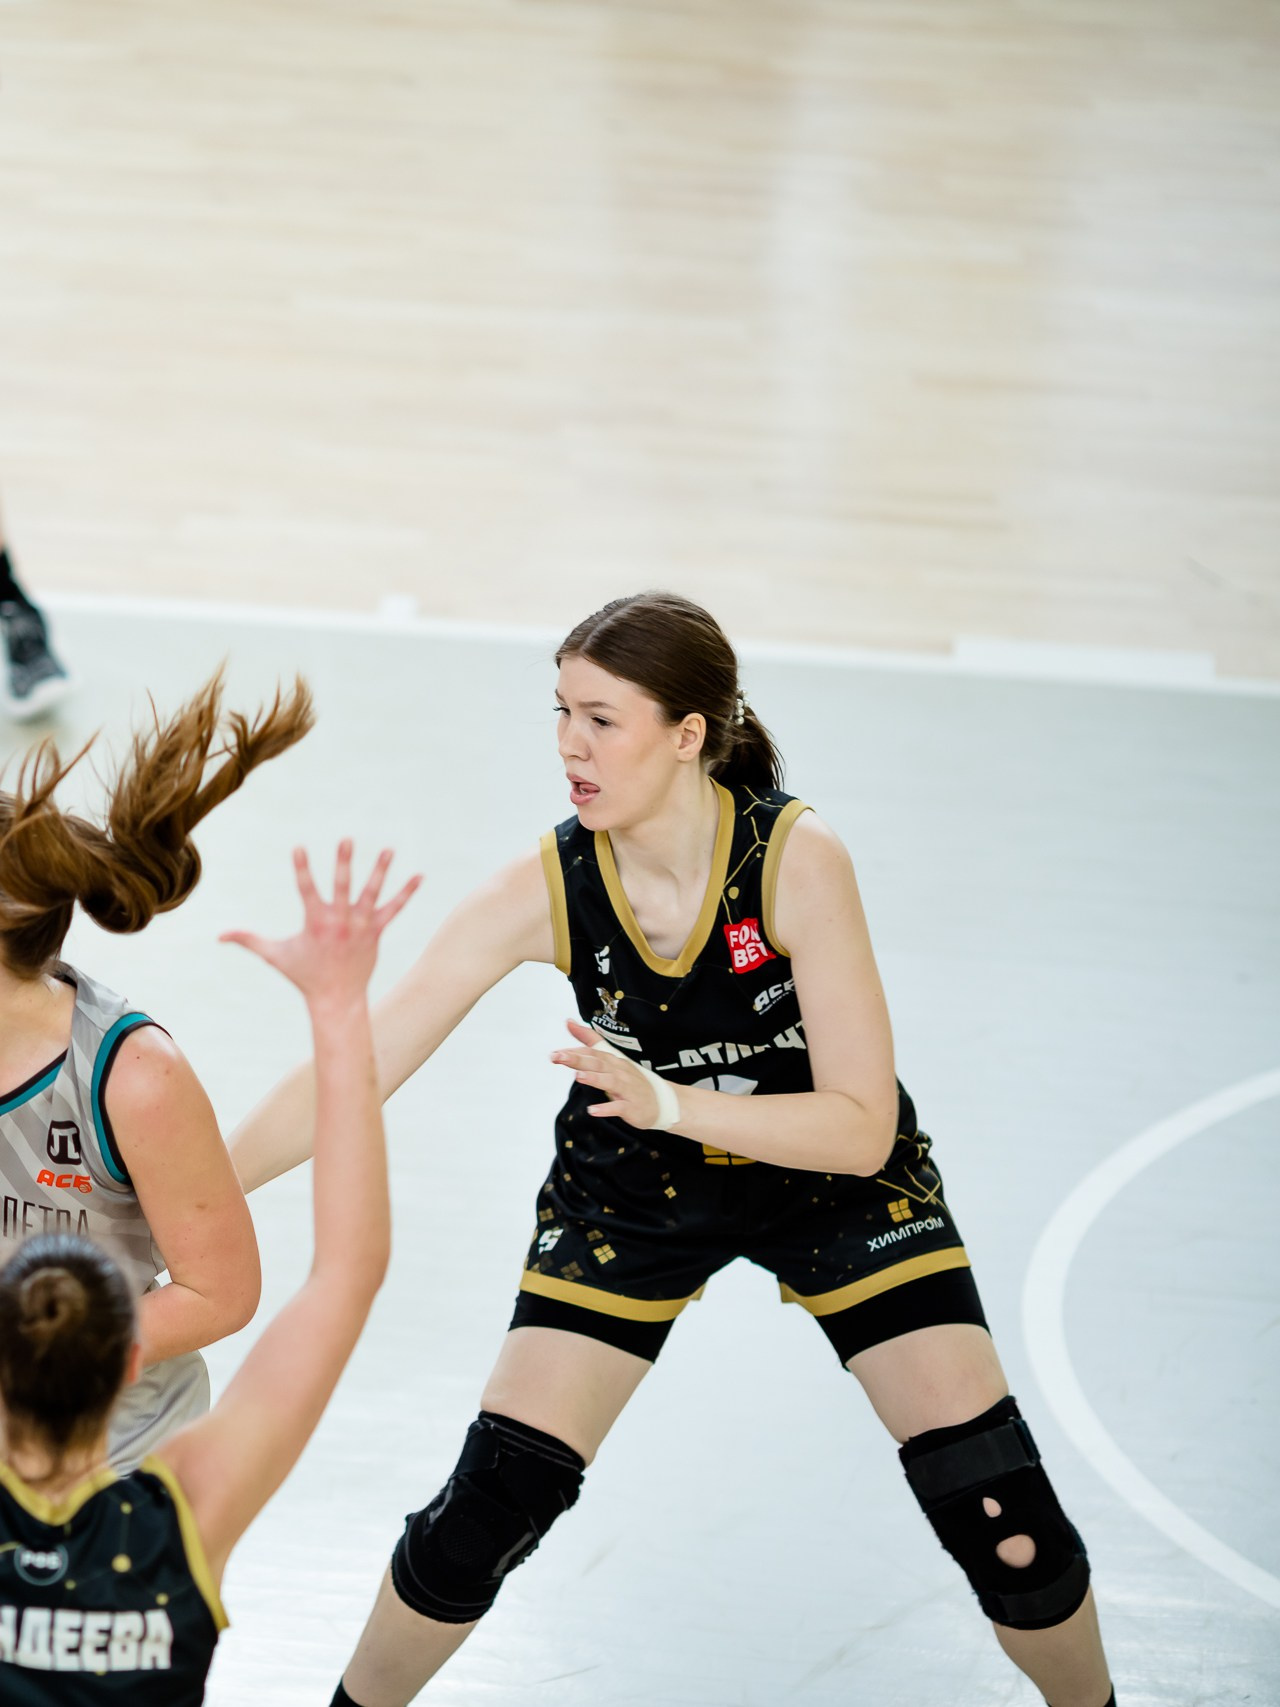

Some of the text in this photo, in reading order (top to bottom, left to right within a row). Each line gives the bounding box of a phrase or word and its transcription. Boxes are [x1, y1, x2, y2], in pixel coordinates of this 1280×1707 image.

[729, 923, 761, 947] FON
[733, 942, 768, 968] BET
[37, 1169, 92, 1194] АСБ
[867, 1216, 945, 1253] ХИМПРОМ
